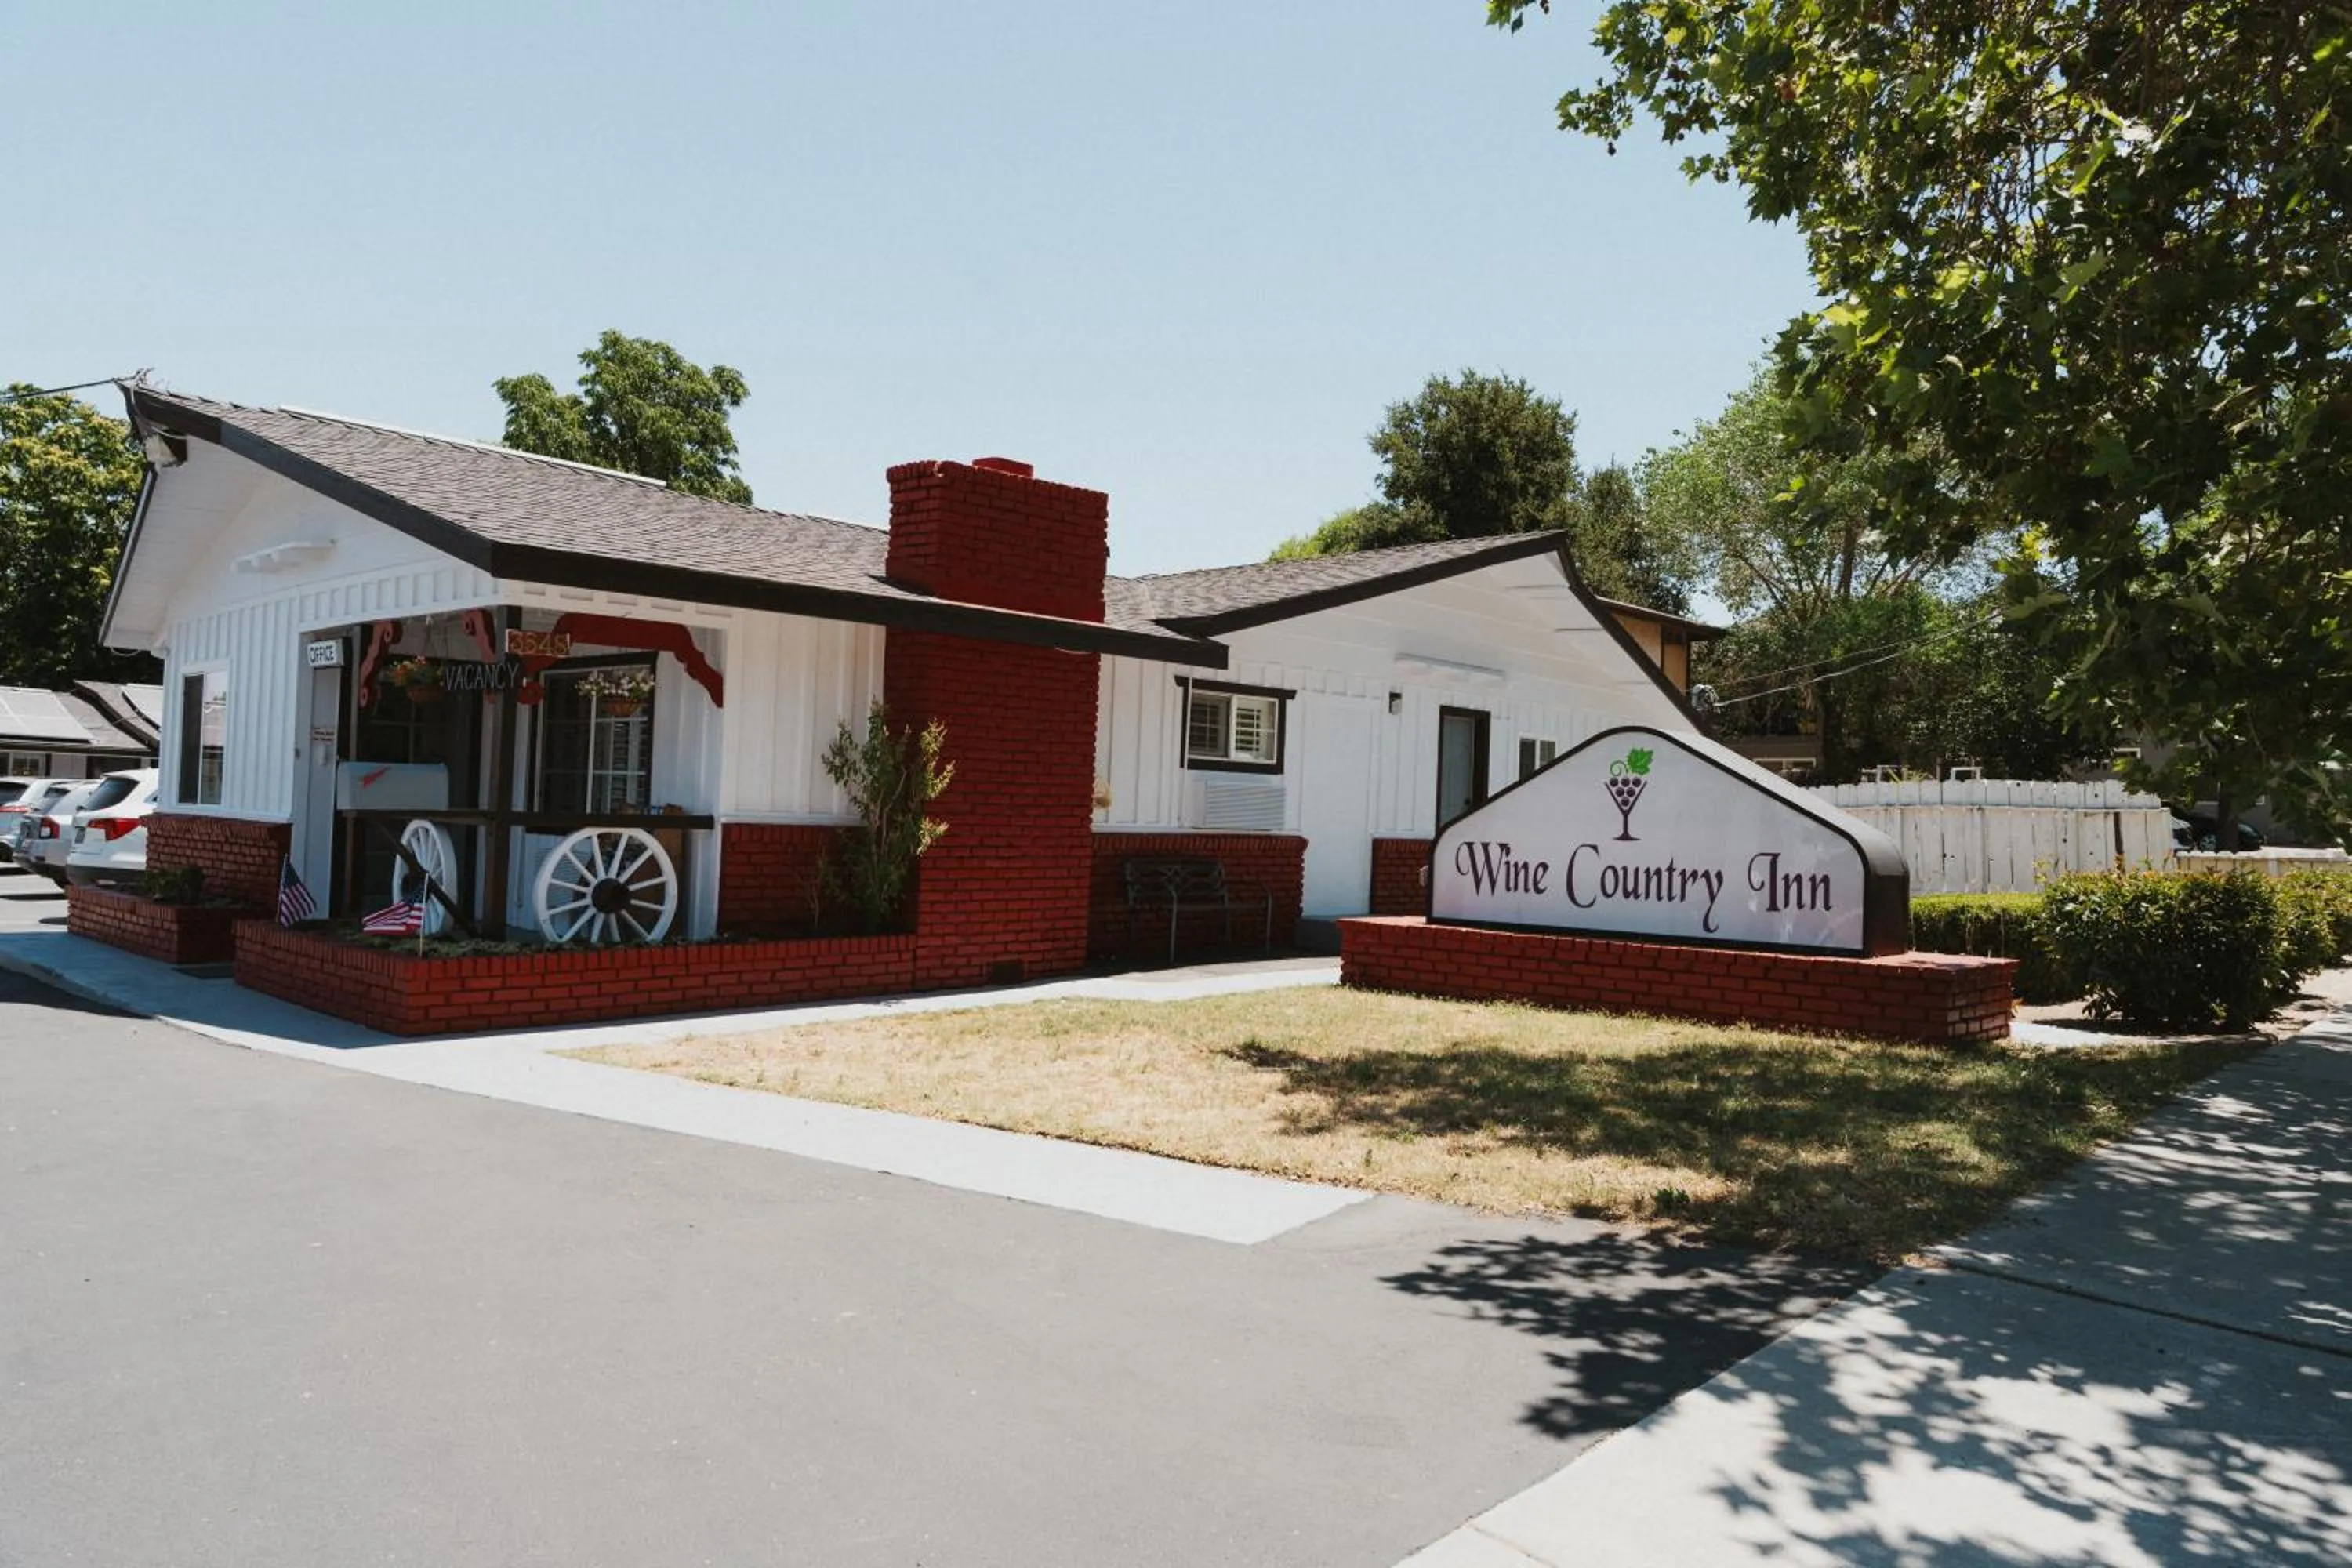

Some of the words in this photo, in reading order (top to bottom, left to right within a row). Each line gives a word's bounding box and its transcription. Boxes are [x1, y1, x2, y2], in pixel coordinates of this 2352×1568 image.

[310, 644, 335, 663] OFFICE
[446, 662, 520, 690] VACANCY
[1455, 841, 1549, 895] Wine
[1566, 844, 1724, 933] Country
[1748, 852, 1832, 913] Inn
